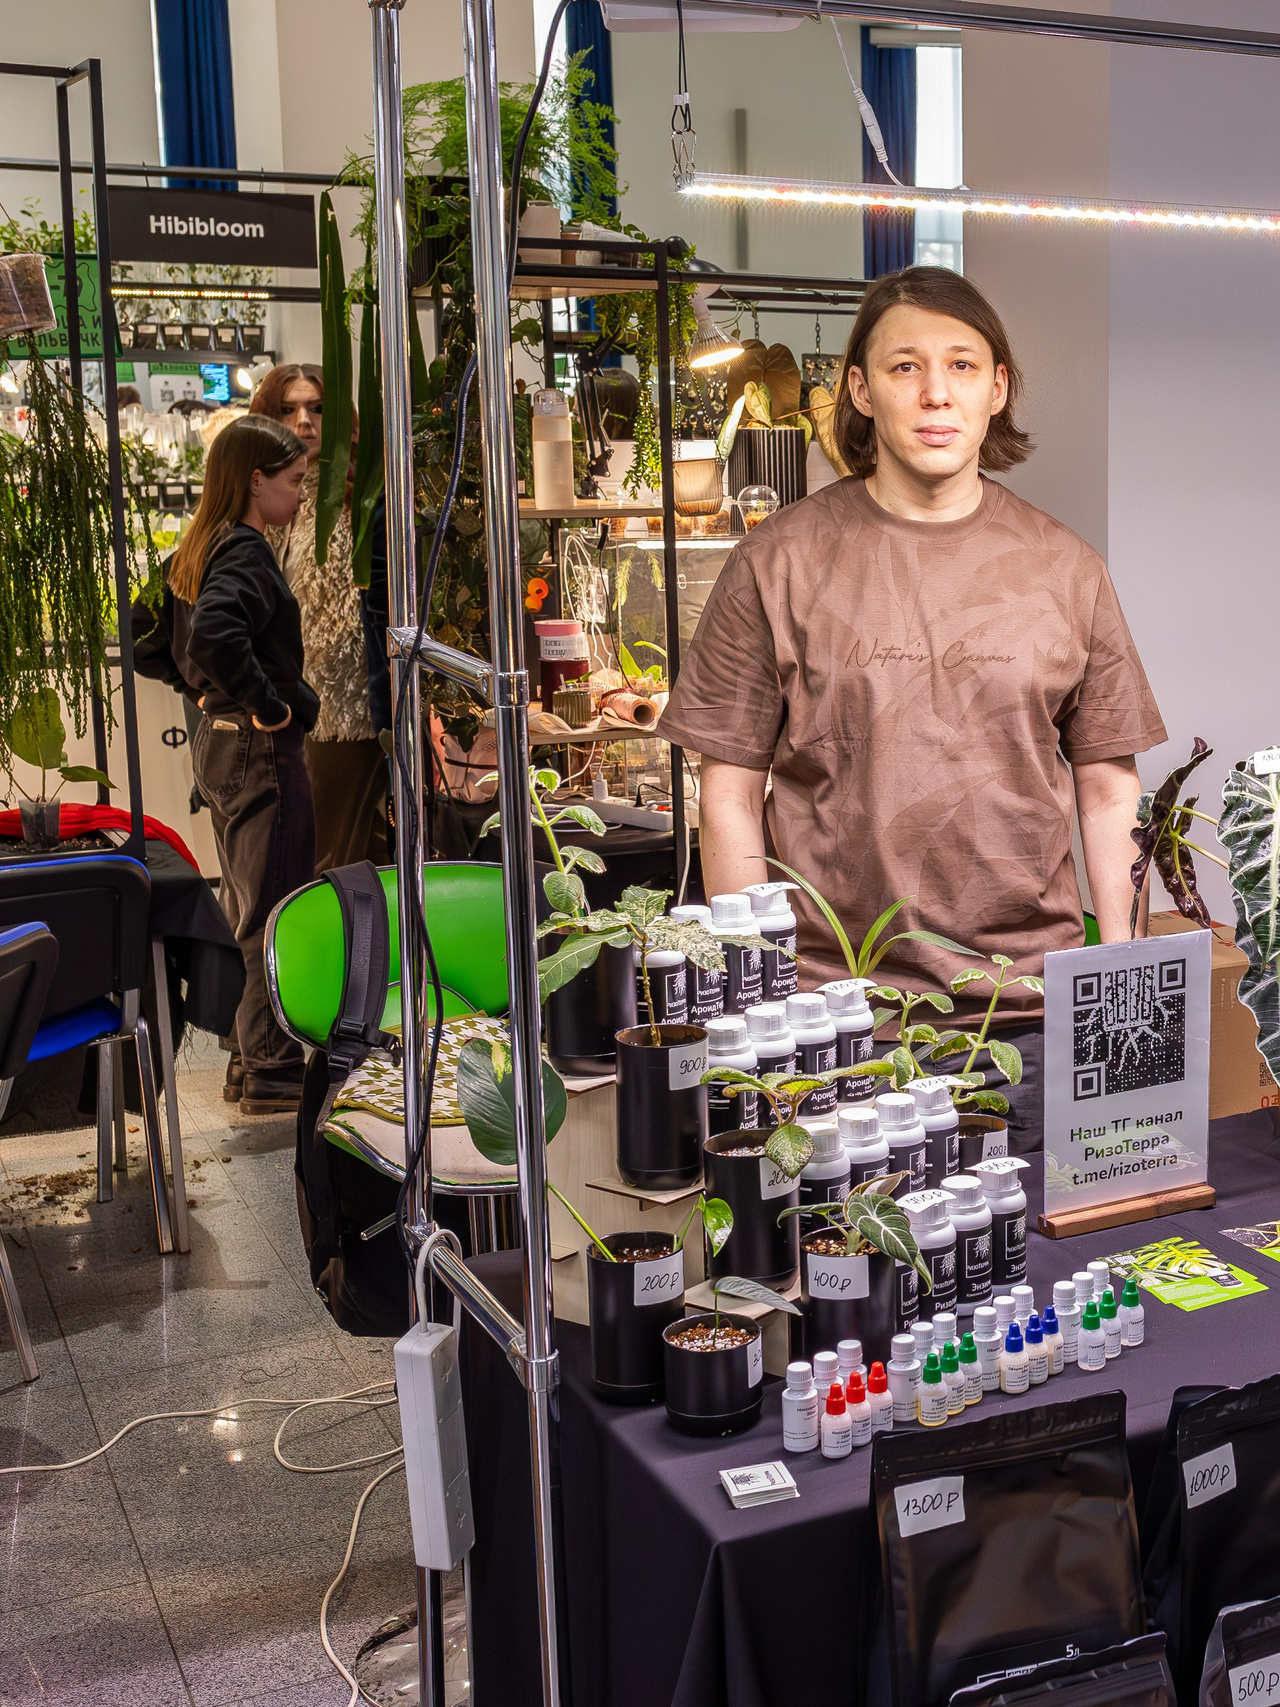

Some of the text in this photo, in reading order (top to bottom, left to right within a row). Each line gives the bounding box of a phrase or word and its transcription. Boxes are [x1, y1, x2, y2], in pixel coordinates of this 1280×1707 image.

[149, 215, 265, 238] Hibibloom
[845, 638, 1017, 670] Nature's Canvas
[161, 726, 188, 749] Ф
[1070, 1110, 1183, 1142] Наш ТГ канал
[1084, 1134, 1170, 1161] РизоТерра
[1072, 1154, 1178, 1185] t.me/rizoterra
[641, 1272, 680, 1292] 200₽
[813, 1270, 852, 1292] 400₽
[903, 1492, 960, 1517] 1300₽
[1238, 1669, 1280, 1701] 500₽
